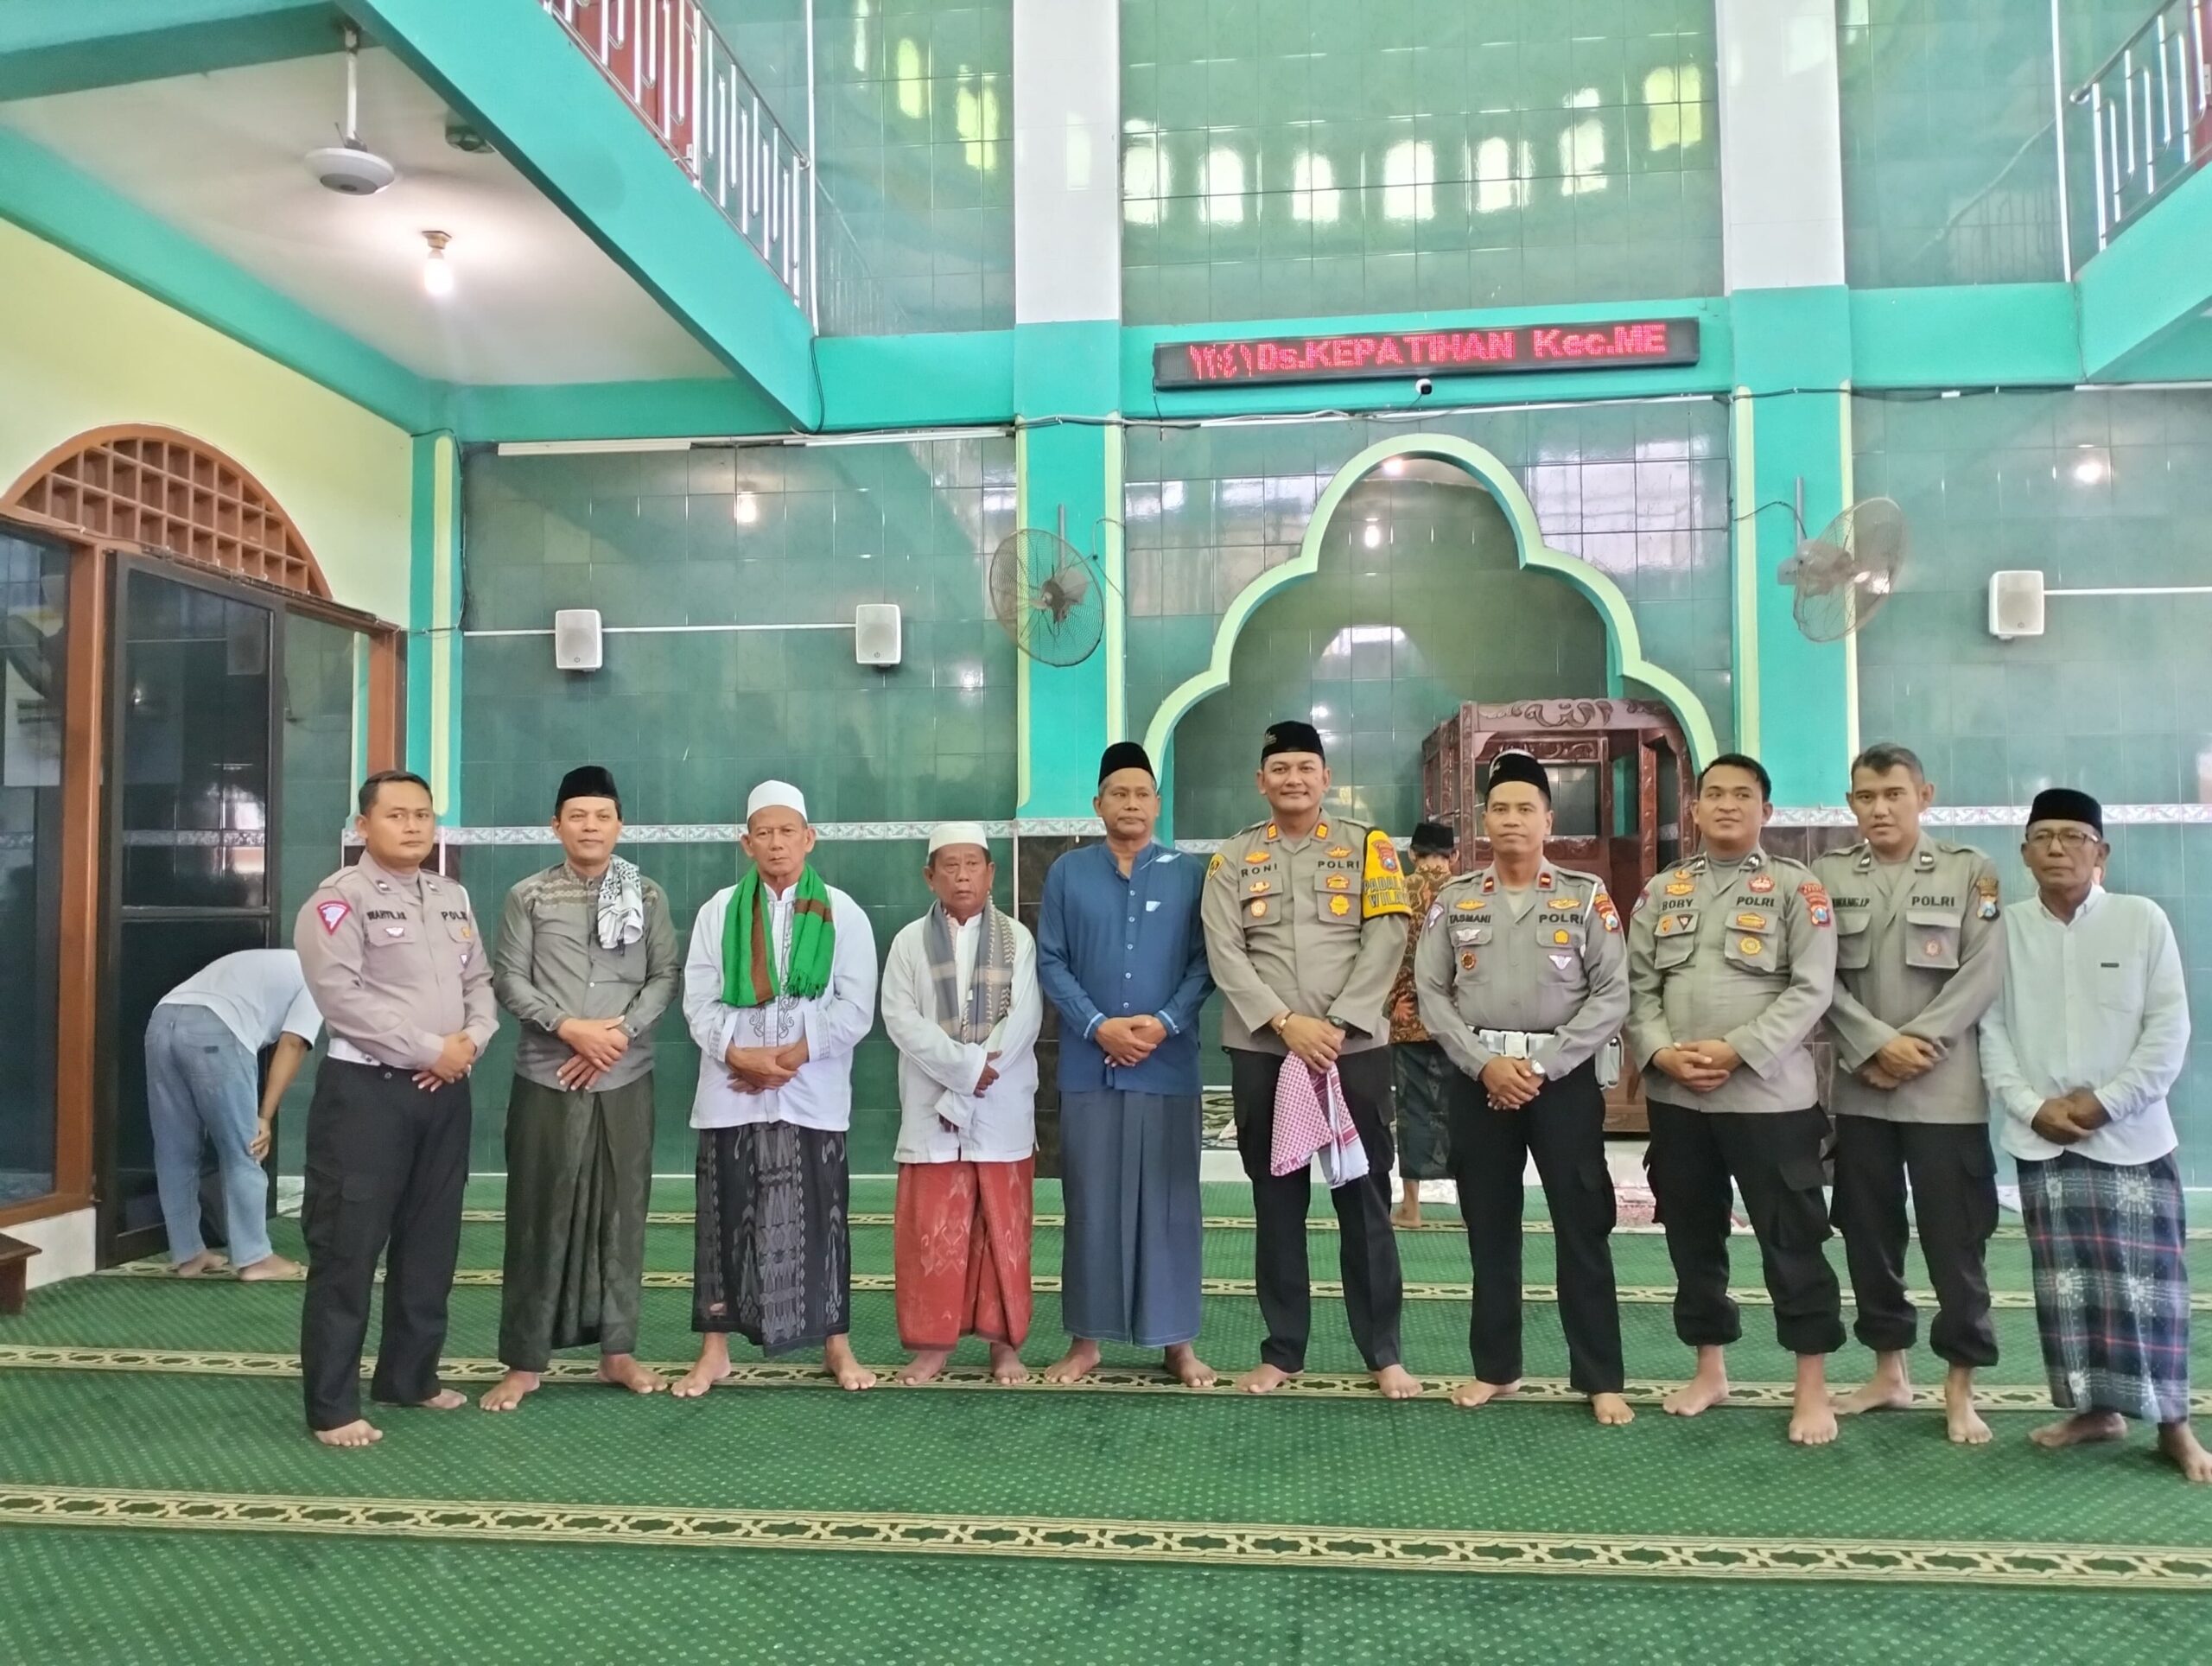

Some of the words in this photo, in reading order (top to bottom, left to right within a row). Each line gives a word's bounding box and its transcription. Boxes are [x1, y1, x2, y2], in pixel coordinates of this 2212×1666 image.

[1241, 862, 1278, 878] RONI
[1318, 861, 1360, 869] POLRI
[1736, 896, 1775, 907] POLRI
[1911, 896, 1955, 907] POLRI
[441, 911, 467, 921] POLR
[1449, 913, 1491, 925] TASMANI
[1539, 913, 1584, 925] POLRI
